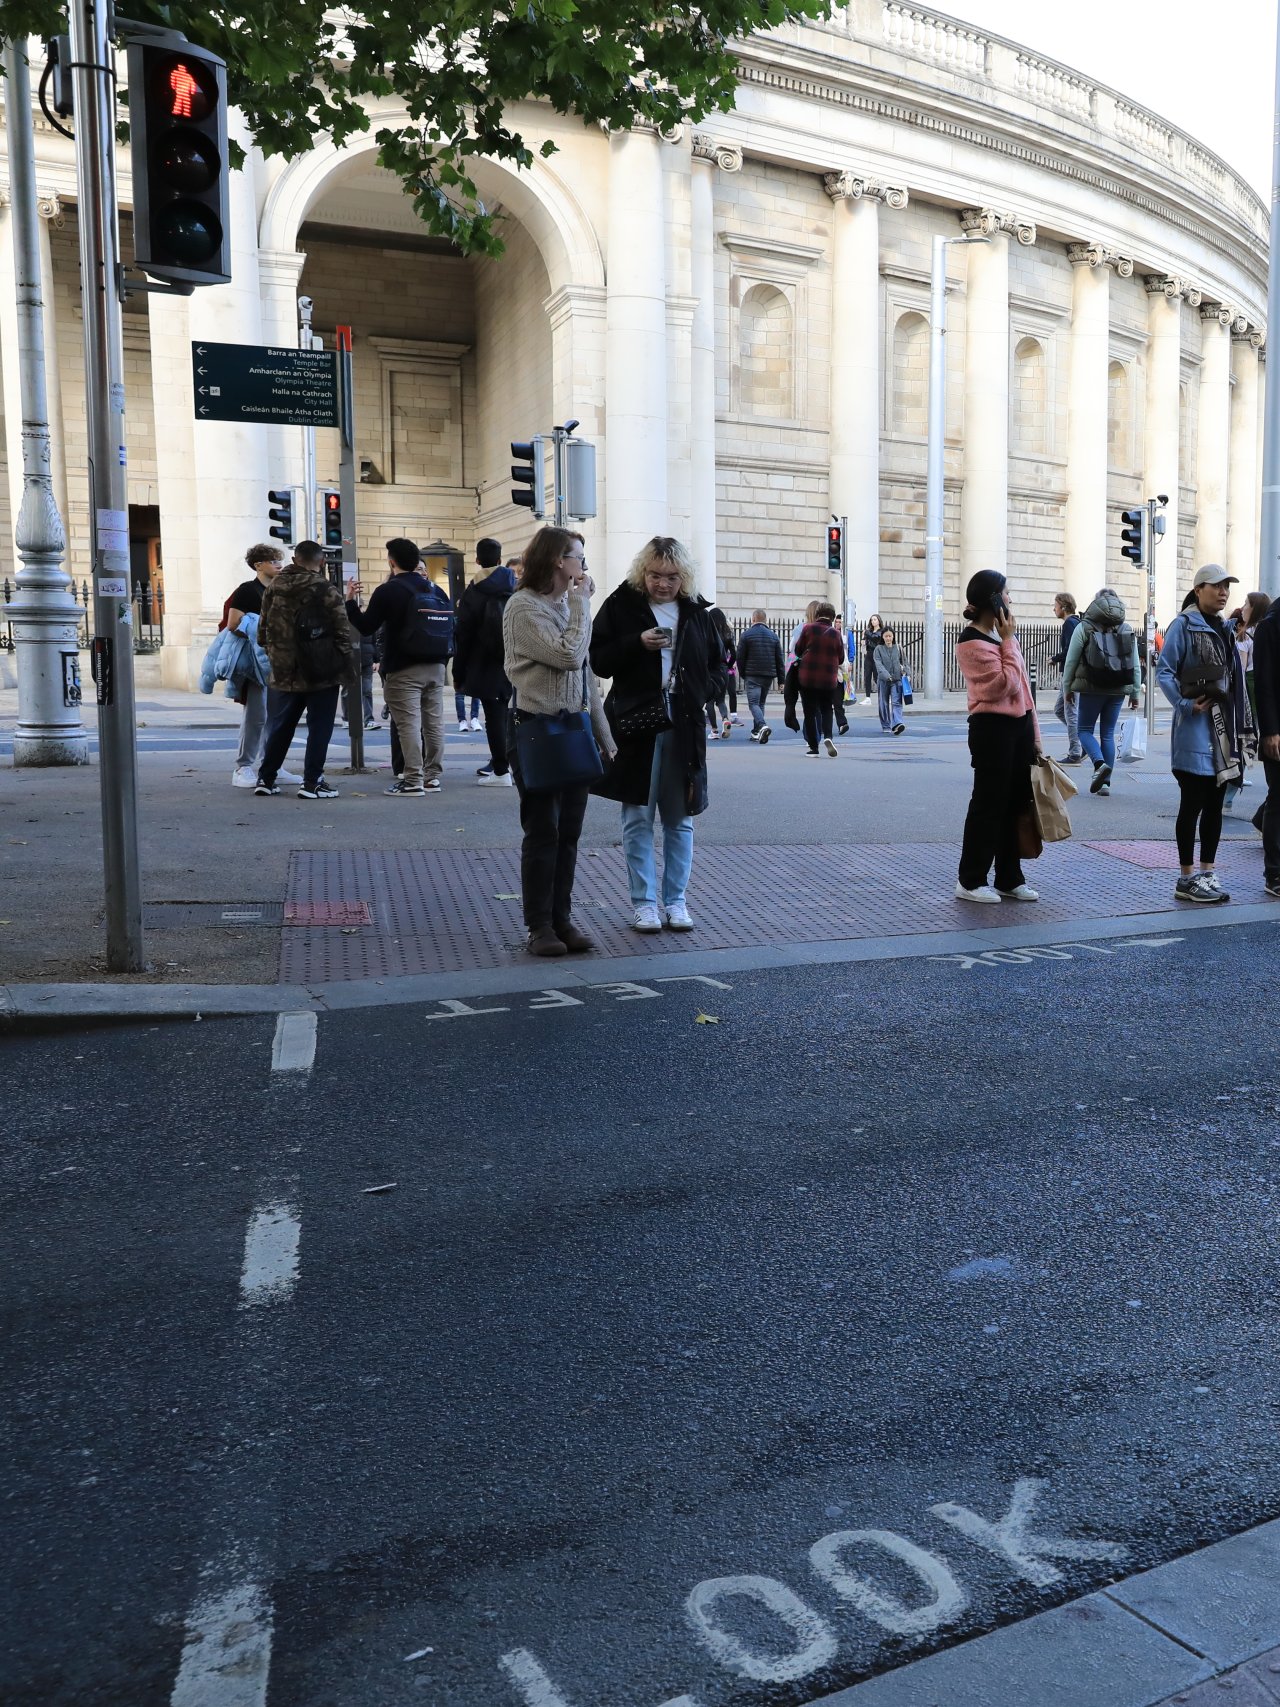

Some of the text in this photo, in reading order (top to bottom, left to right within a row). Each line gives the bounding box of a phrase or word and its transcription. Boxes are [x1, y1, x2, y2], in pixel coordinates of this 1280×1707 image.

[299, 352, 332, 361] Teampaill
[303, 371, 332, 379] Olympia
[302, 390, 333, 398] Cathrach
[305, 398, 318, 406] City
[241, 405, 270, 413] Caisleán
[313, 409, 333, 417] Cliath
[288, 416, 312, 424] Dublin
[425, 943, 1117, 1020] LOOK LEFT
[499, 1477, 1130, 1707] LOOK
